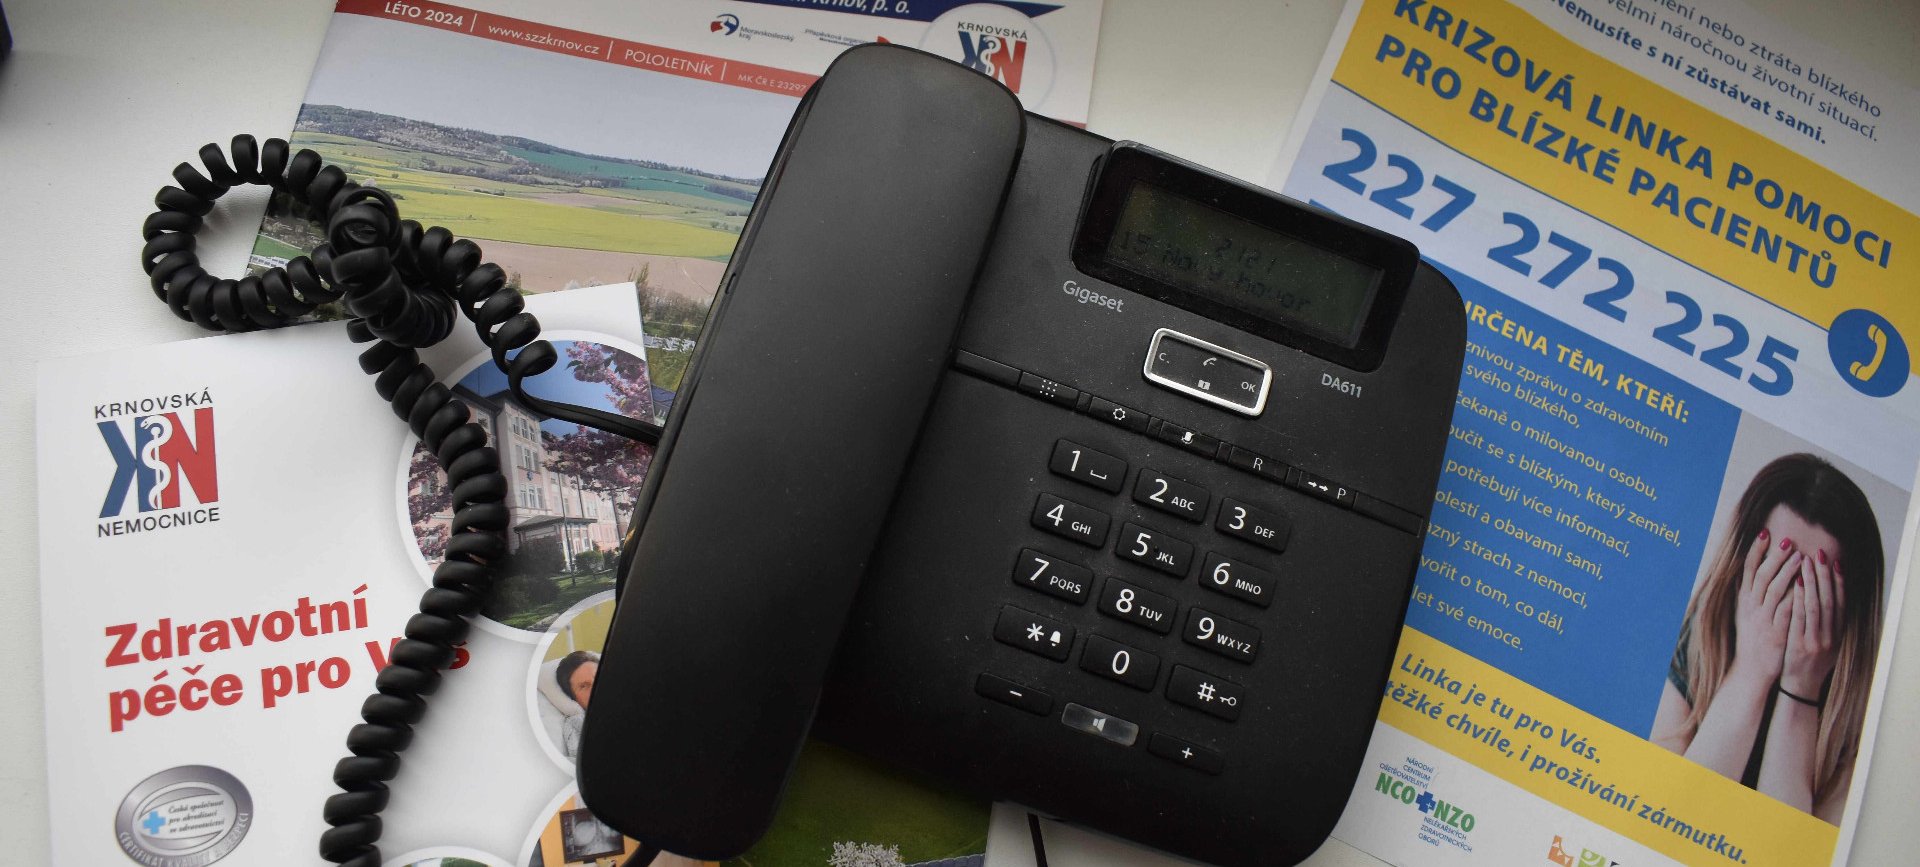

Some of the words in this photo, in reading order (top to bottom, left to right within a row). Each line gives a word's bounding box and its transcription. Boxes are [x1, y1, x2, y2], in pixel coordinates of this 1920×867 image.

[384, 1, 421, 18] LÉTO
[424, 9, 463, 27] 2024
[872, 0, 888, 13] p.
[895, 1, 910, 13] o.
[488, 23, 599, 54] www.szzkrnov.cz
[958, 21, 1028, 40] KRNOVSKÁ
[624, 48, 714, 76] POLOLETNÍK
[738, 74, 753, 84] MK
[769, 79, 775, 87] E
[1699, 14, 1745, 47] nebo
[1749, 42, 1801, 76] ztráta
[1808, 68, 1881, 117] blízkého
[1647, 45, 1657, 58] s
[1662, 52, 1683, 70] ní
[1685, 64, 1772, 116] zůstávat
[1775, 110, 1826, 144] sami.
[1660, 20, 1747, 72] náročnou
[1752, 64, 1815, 106] životní
[1818, 99, 1877, 142] situací.
[1394, 0, 1575, 112] KRIZOVÁ
[1586, 94, 1712, 179] LINKA
[1727, 162, 1892, 269] POMOCI
[1375, 33, 1461, 100] PRO
[1469, 87, 1620, 185] BLÍZKÉ
[1628, 167, 1837, 289] PACIENTŮ
[1322, 128, 1476, 232] 227
[1487, 212, 1634, 323] 272
[1652, 290, 1799, 397] 225
[1063, 280, 1124, 312] Gigaset
[1241, 381, 1255, 393] OK
[1321, 373, 1362, 398] DA611
[1466, 363, 1511, 393] svého
[1515, 384, 1580, 429] blízkého,
[1556, 343, 1609, 386] TĚM,
[1616, 373, 1689, 423] KTEŘÍ:
[95, 387, 213, 418] KRNOVSKÁ
[1516, 364, 1568, 398] zprávu
[1571, 392, 1582, 404] o
[1584, 397, 1669, 447] zdravotním
[1070, 450, 1081, 472] 1
[1253, 457, 1263, 470] R
[1511, 420, 1521, 432] o
[1525, 426, 1605, 473] milovanou
[1609, 466, 1657, 501] osobu,
[1149, 478, 1168, 503] 2
[1171, 496, 1195, 511] ABC
[1337, 487, 1346, 499] P
[1445, 458, 1521, 502] potřebují
[1523, 494, 1553, 517] více
[1556, 508, 1630, 557] informací,
[1486, 442, 1504, 459] se
[1507, 451, 1516, 464] s
[1519, 455, 1582, 498] blízkým,
[1586, 486, 1626, 519] který
[1627, 509, 1681, 547] zemřel,
[98, 507, 220, 537] NEMOCNICE
[1046, 504, 1064, 527] 4
[1071, 521, 1092, 535] GHI
[1229, 507, 1247, 530] 3
[1254, 525, 1275, 539] DEF
[1435, 488, 1480, 518] olestí
[1480, 512, 1490, 524] a
[1494, 517, 1563, 558] obavami
[1565, 550, 1604, 580] sami,
[1131, 533, 1151, 556] 5
[1156, 551, 1175, 565] JKL
[1029, 557, 1049, 581] 7
[1050, 575, 1082, 594] PQRS
[1213, 562, 1231, 585] 6
[1235, 578, 1261, 595] MNO
[1463, 537, 1512, 570] strach
[1514, 563, 1524, 576] z
[1527, 568, 1588, 609] nemoci,
[1115, 588, 1135, 613] 8
[1140, 605, 1163, 622] TUV
[1420, 554, 1458, 581] vořit
[1460, 575, 1471, 588] o
[1475, 579, 1510, 608] tom,
[1515, 601, 1534, 617] co
[1538, 610, 1564, 635] dál,
[105, 583, 368, 668] Zdravotní
[1196, 617, 1215, 640] 9
[1217, 633, 1251, 654] WXYZ
[1437, 600, 1464, 622] své
[1467, 614, 1523, 651] emoce.
[1112, 650, 1130, 675] 0
[109, 664, 243, 732] péče
[260, 656, 351, 708] pro
[1401, 653, 1462, 697] Linka
[1463, 683, 1487, 708] je
[1490, 697, 1514, 719] tu
[1514, 713, 1554, 740] pro
[1561, 728, 1601, 763] Vás.
[1384, 680, 1444, 720] těžké
[1446, 708, 1514, 757] chvíle,
[1520, 744, 1531, 762] i
[1529, 753, 1638, 811] prožívání
[1637, 802, 1748, 864] zármutku.
[1402, 764, 1430, 781] CENTRUM
[1375, 772, 1415, 804] NCO
[1433, 800, 1475, 832] NZO
